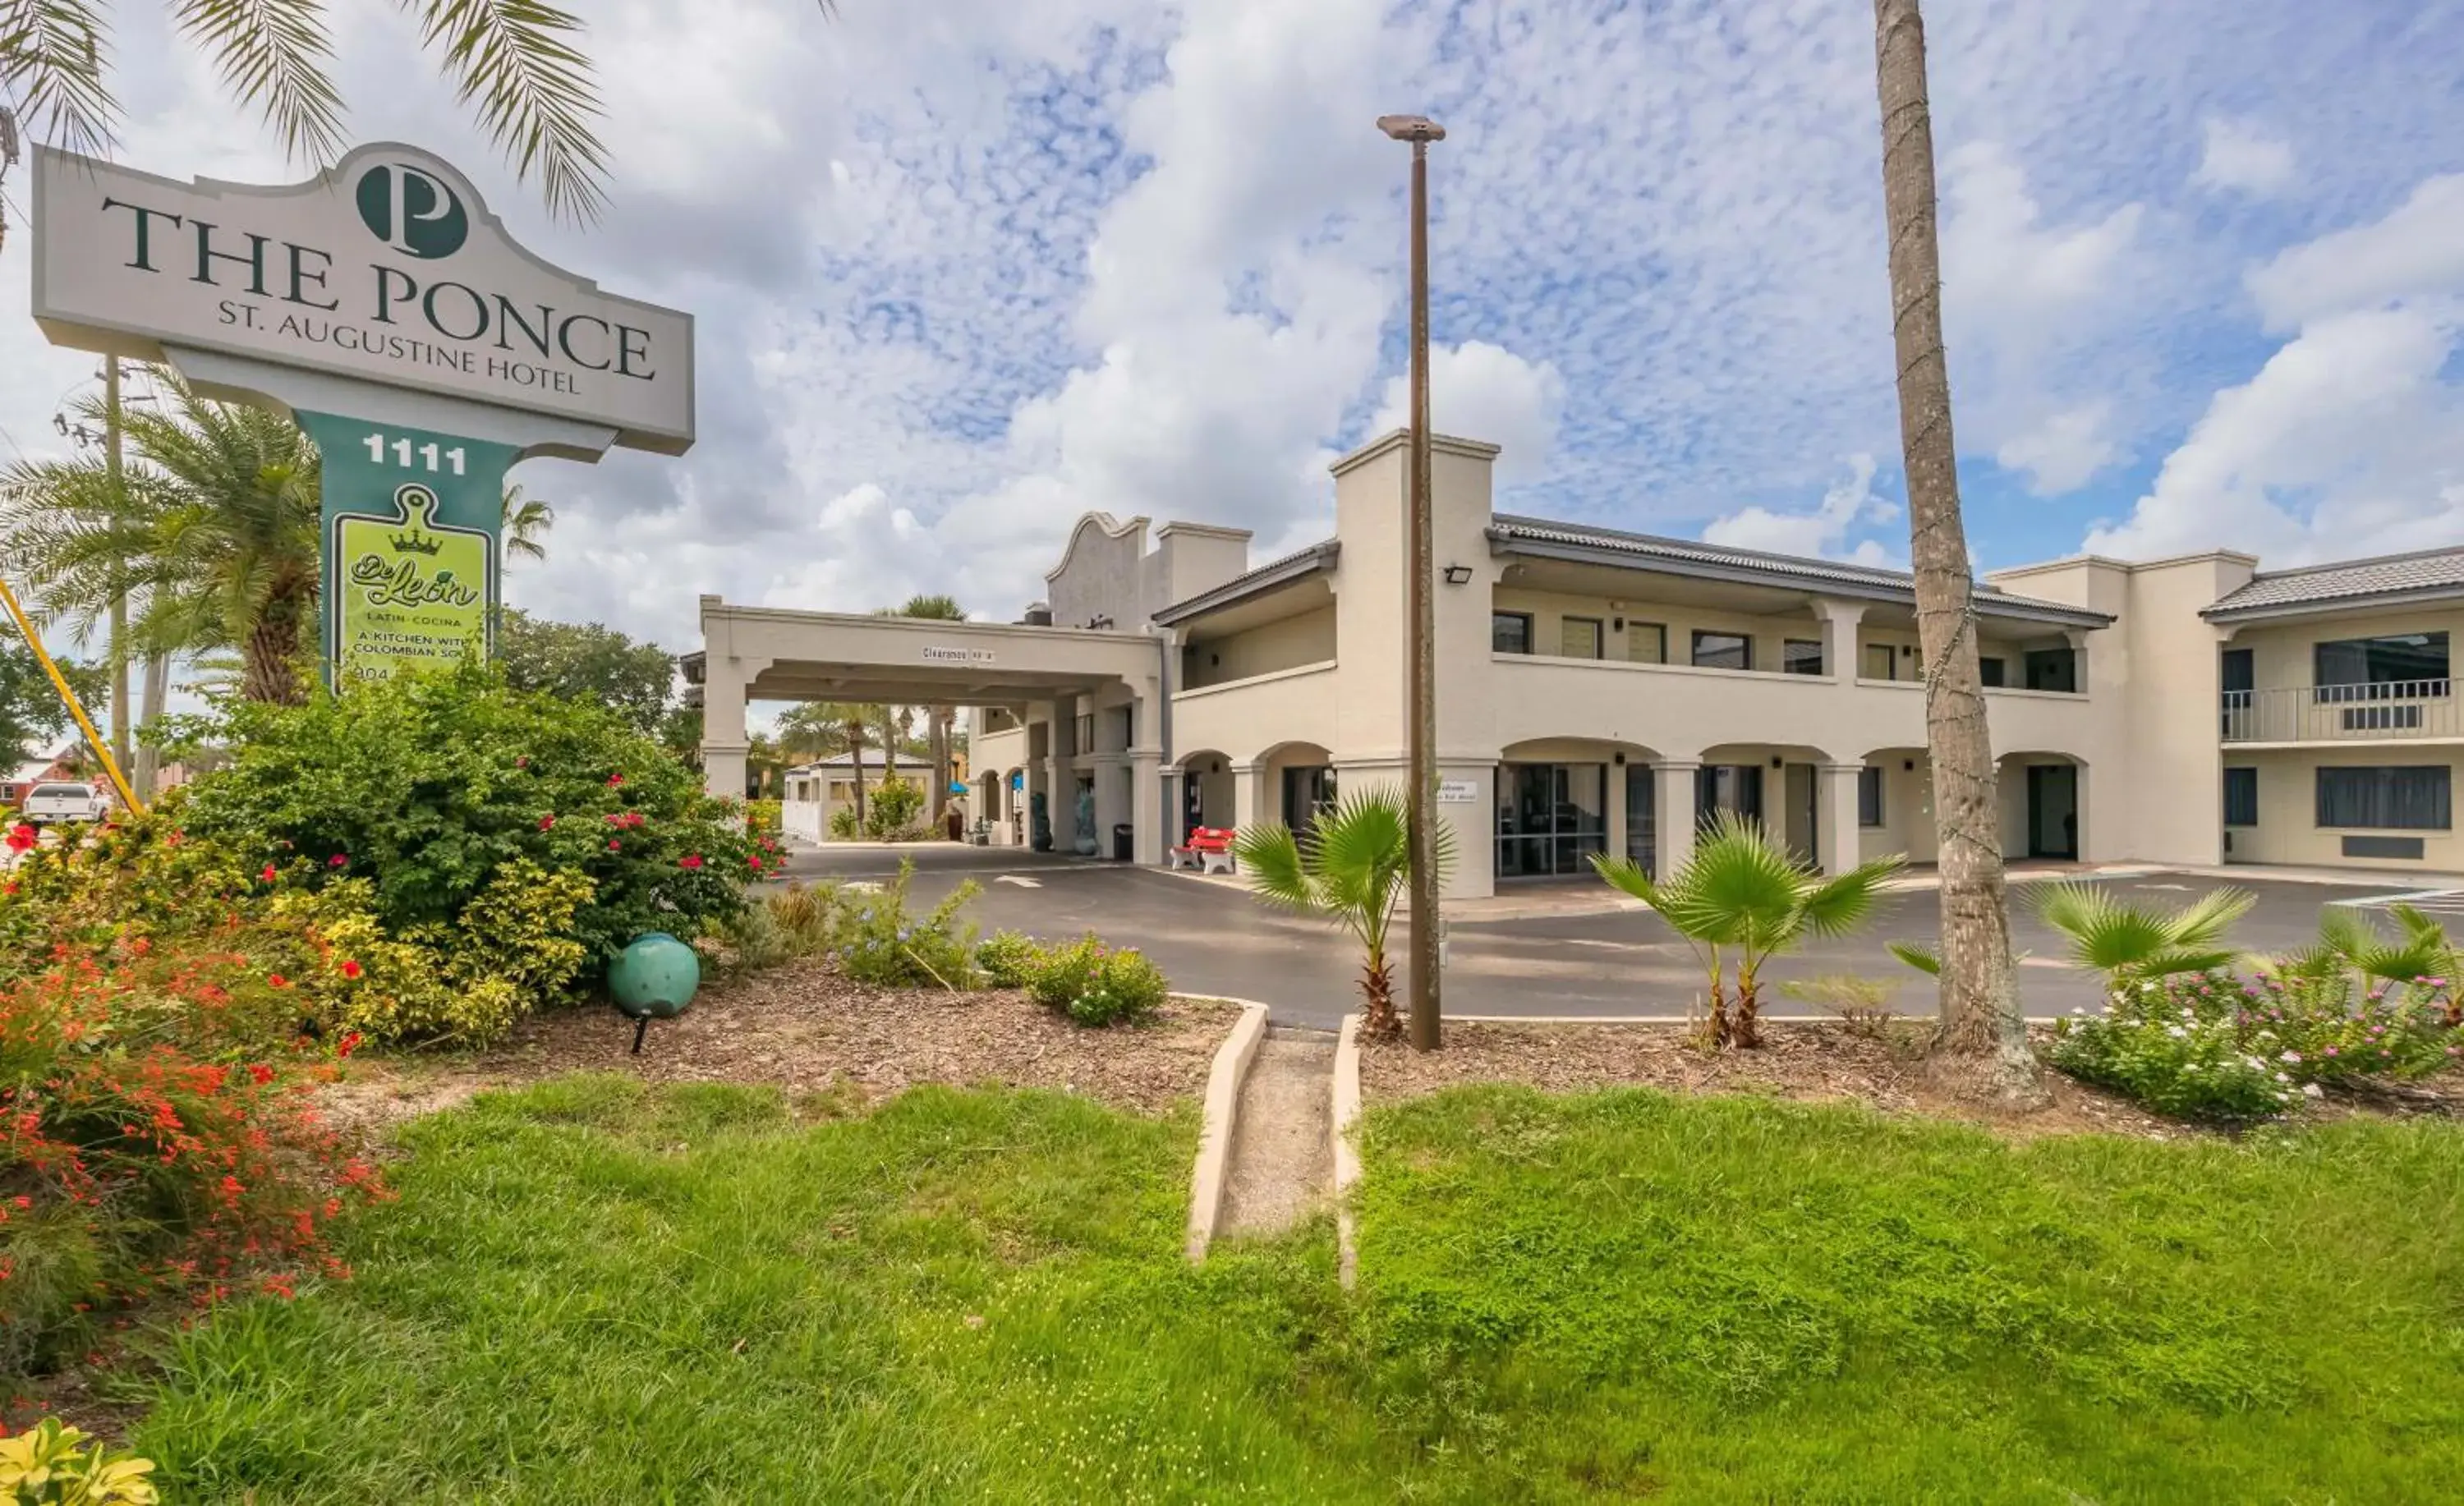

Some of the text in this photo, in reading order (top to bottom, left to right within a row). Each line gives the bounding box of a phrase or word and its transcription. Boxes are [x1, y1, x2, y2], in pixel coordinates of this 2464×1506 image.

[384, 163, 453, 256] P
[102, 196, 655, 381] THE PONCE
[218, 300, 582, 395] ST. AUGUSTINE HOTEL
[362, 433, 466, 476] 1111
[367, 612, 462, 627] LATIN COCINA
[353, 643, 435, 657] COLOMBIAN
[358, 631, 368, 641] A
[374, 631, 434, 645] KITCHEN
[354, 667, 388, 680] 904
